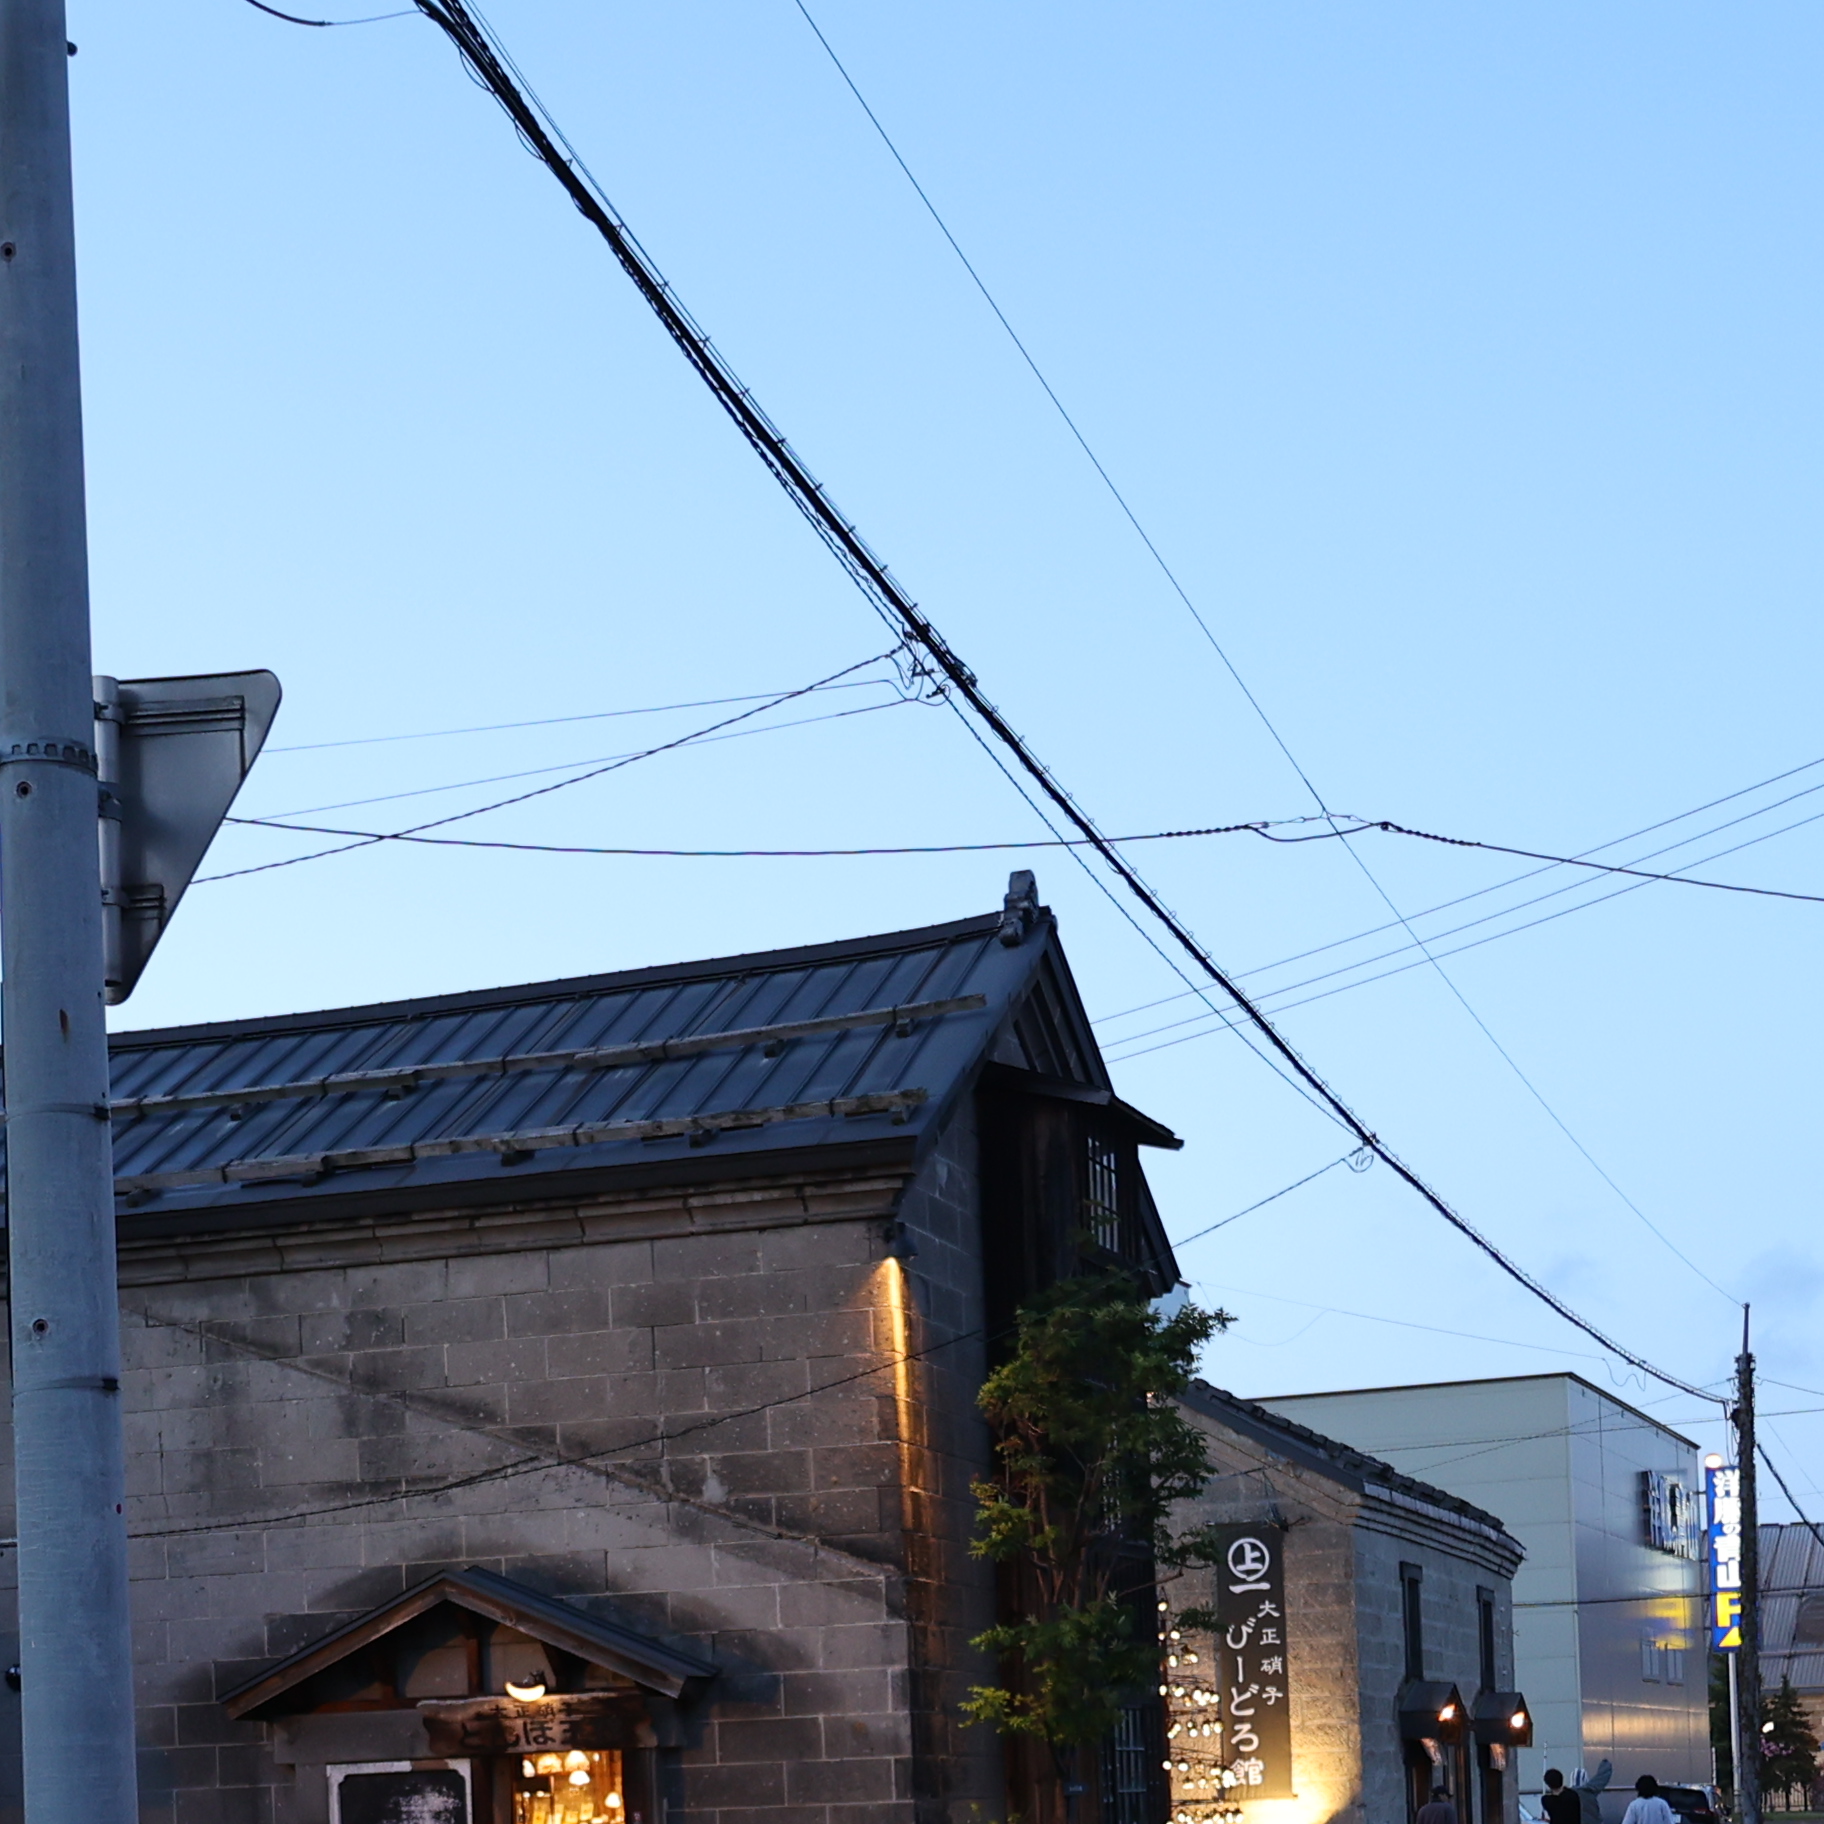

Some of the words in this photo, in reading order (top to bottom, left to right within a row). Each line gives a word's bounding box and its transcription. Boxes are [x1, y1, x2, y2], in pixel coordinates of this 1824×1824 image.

[1226, 1617, 1265, 1787] びーどろ館
[1256, 1600, 1284, 1706] 大正硝子
